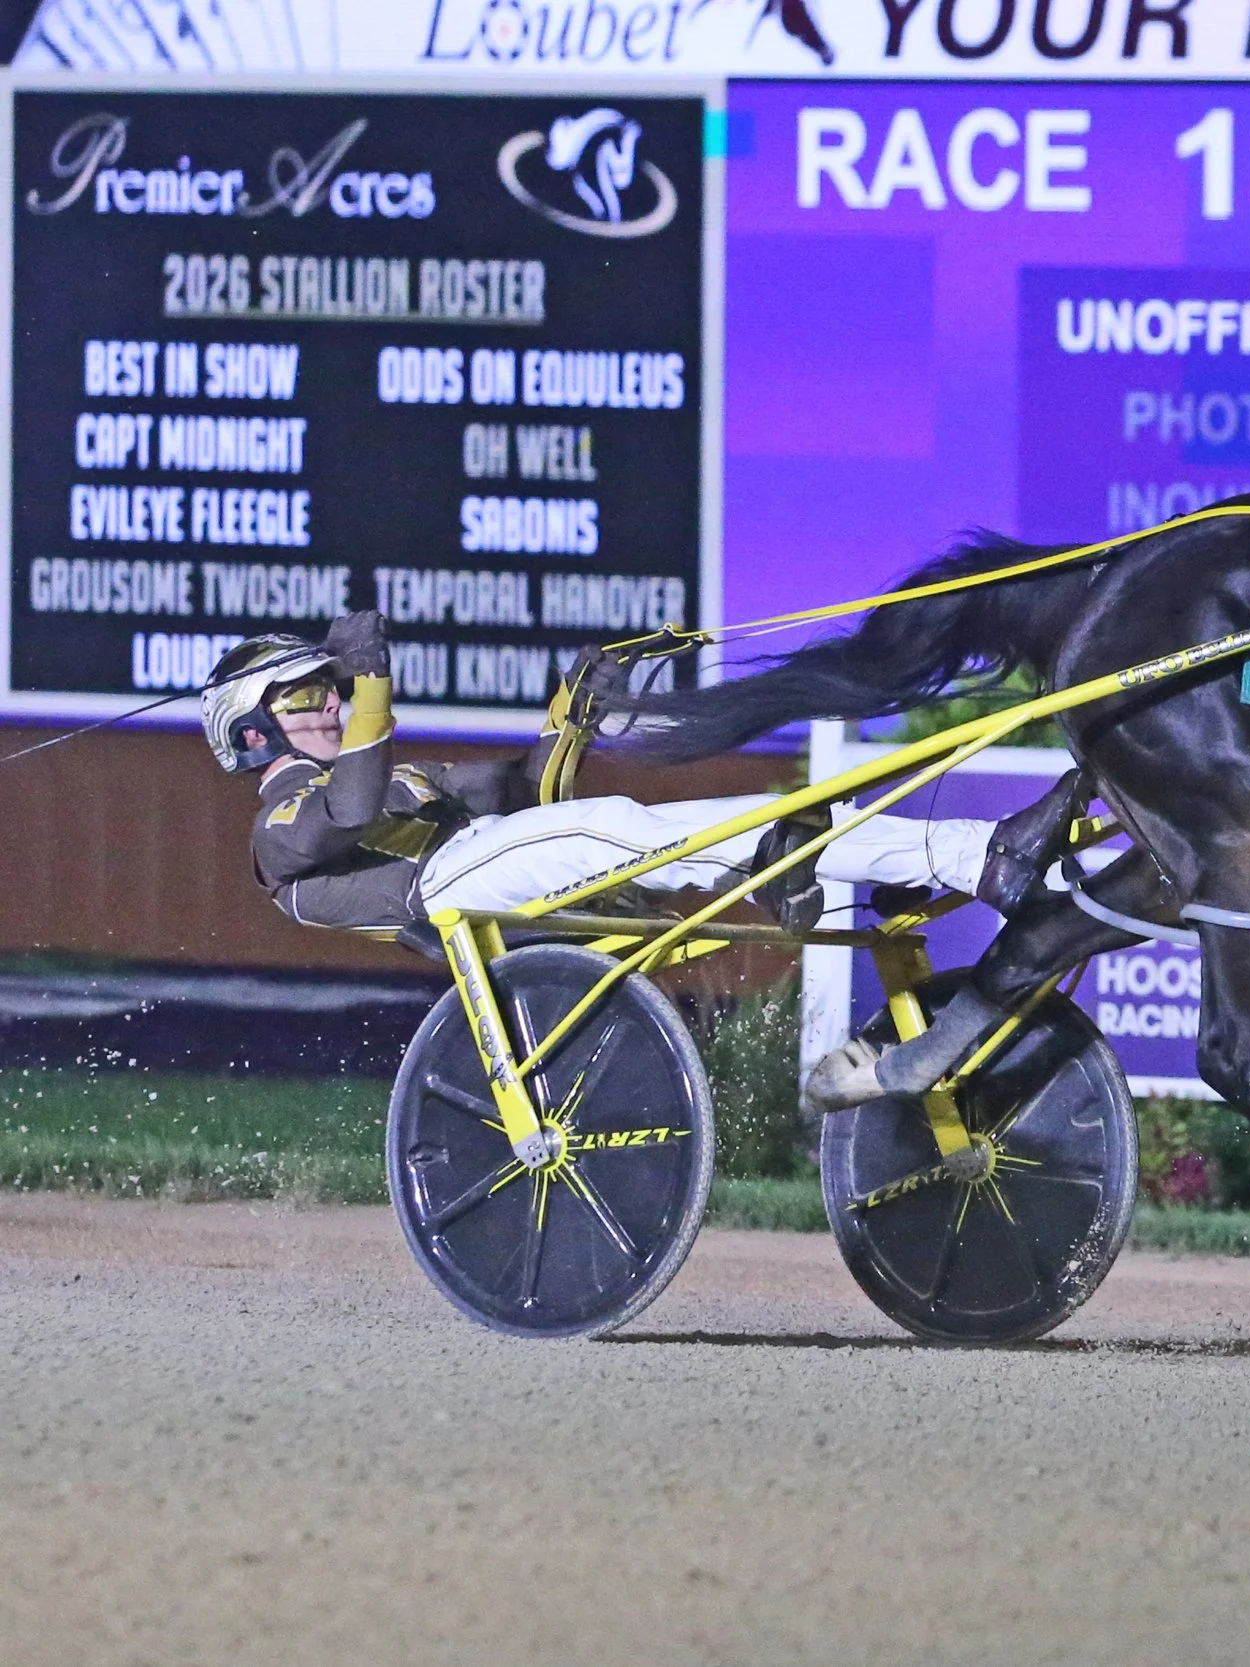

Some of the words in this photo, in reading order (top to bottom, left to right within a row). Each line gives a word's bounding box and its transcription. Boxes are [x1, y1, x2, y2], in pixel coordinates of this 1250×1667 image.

[796, 107, 1092, 212] RACE
[163, 254, 249, 313] 2026
[258, 257, 408, 317] STALLION
[419, 260, 545, 320] ROSTER
[85, 340, 160, 397] BEST
[165, 342, 198, 397] IN
[204, 342, 299, 400] SHOW
[377, 347, 464, 404] ODDS
[471, 349, 516, 405] ON
[522, 350, 685, 409] EQUULEUS
[76, 413, 156, 470] CAPT
[159, 414, 307, 474] MIDNIGHT
[462, 422, 509, 478] OH
[515, 424, 597, 481] WELL
[70, 483, 185, 540] EVILEYE
[192, 487, 311, 546] FLEEGLE
[460, 495, 599, 555] SABONIS
[31, 557, 194, 615] GROUSOME
[202, 561, 350, 619] TWOSOME
[374, 567, 533, 624] TEMPORAL
[541, 573, 685, 630] HANOVER
[455, 643, 549, 700] KNOW
[1119, 655, 1184, 687] UFO
